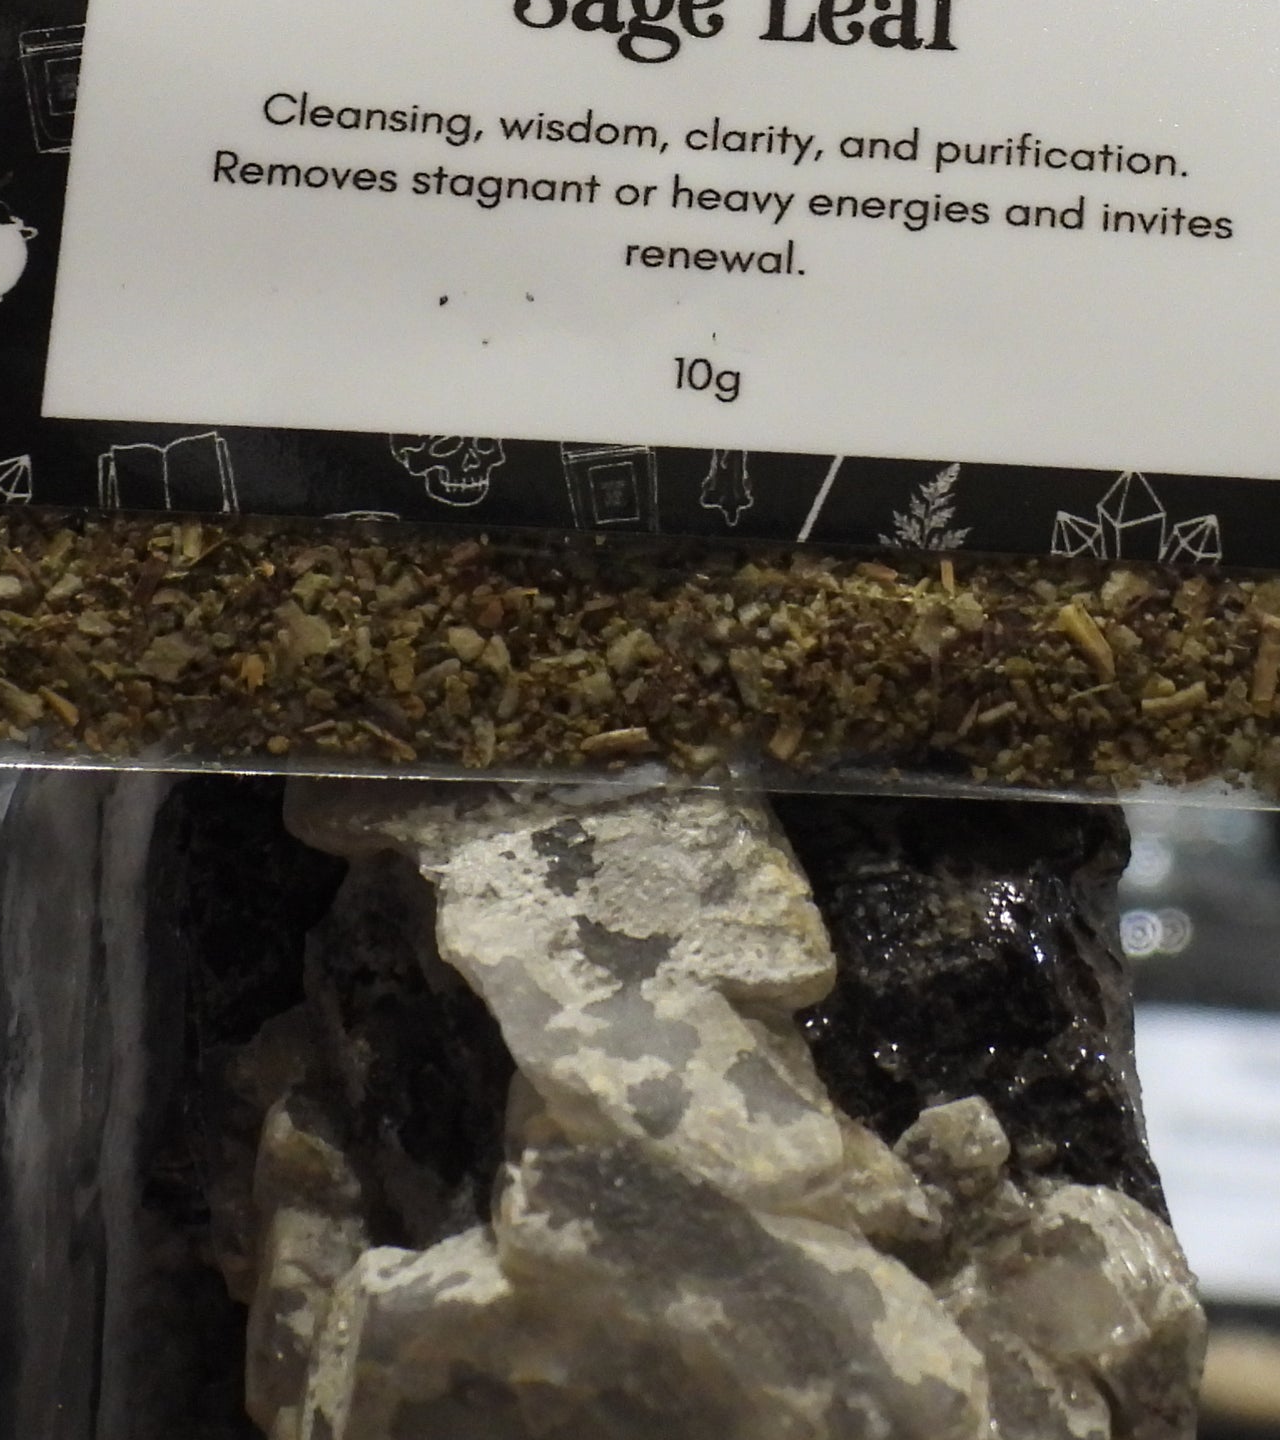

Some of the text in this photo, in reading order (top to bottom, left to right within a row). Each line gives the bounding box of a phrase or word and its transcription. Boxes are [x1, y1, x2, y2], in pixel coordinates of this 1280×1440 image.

[263, 91, 1188, 177] Cleansing, wisdom, clarity, and purification.
[213, 150, 1233, 239] Removes stagnant or heavy energies and invites
[625, 240, 805, 275] renewal.
[674, 357, 740, 403] 10g
